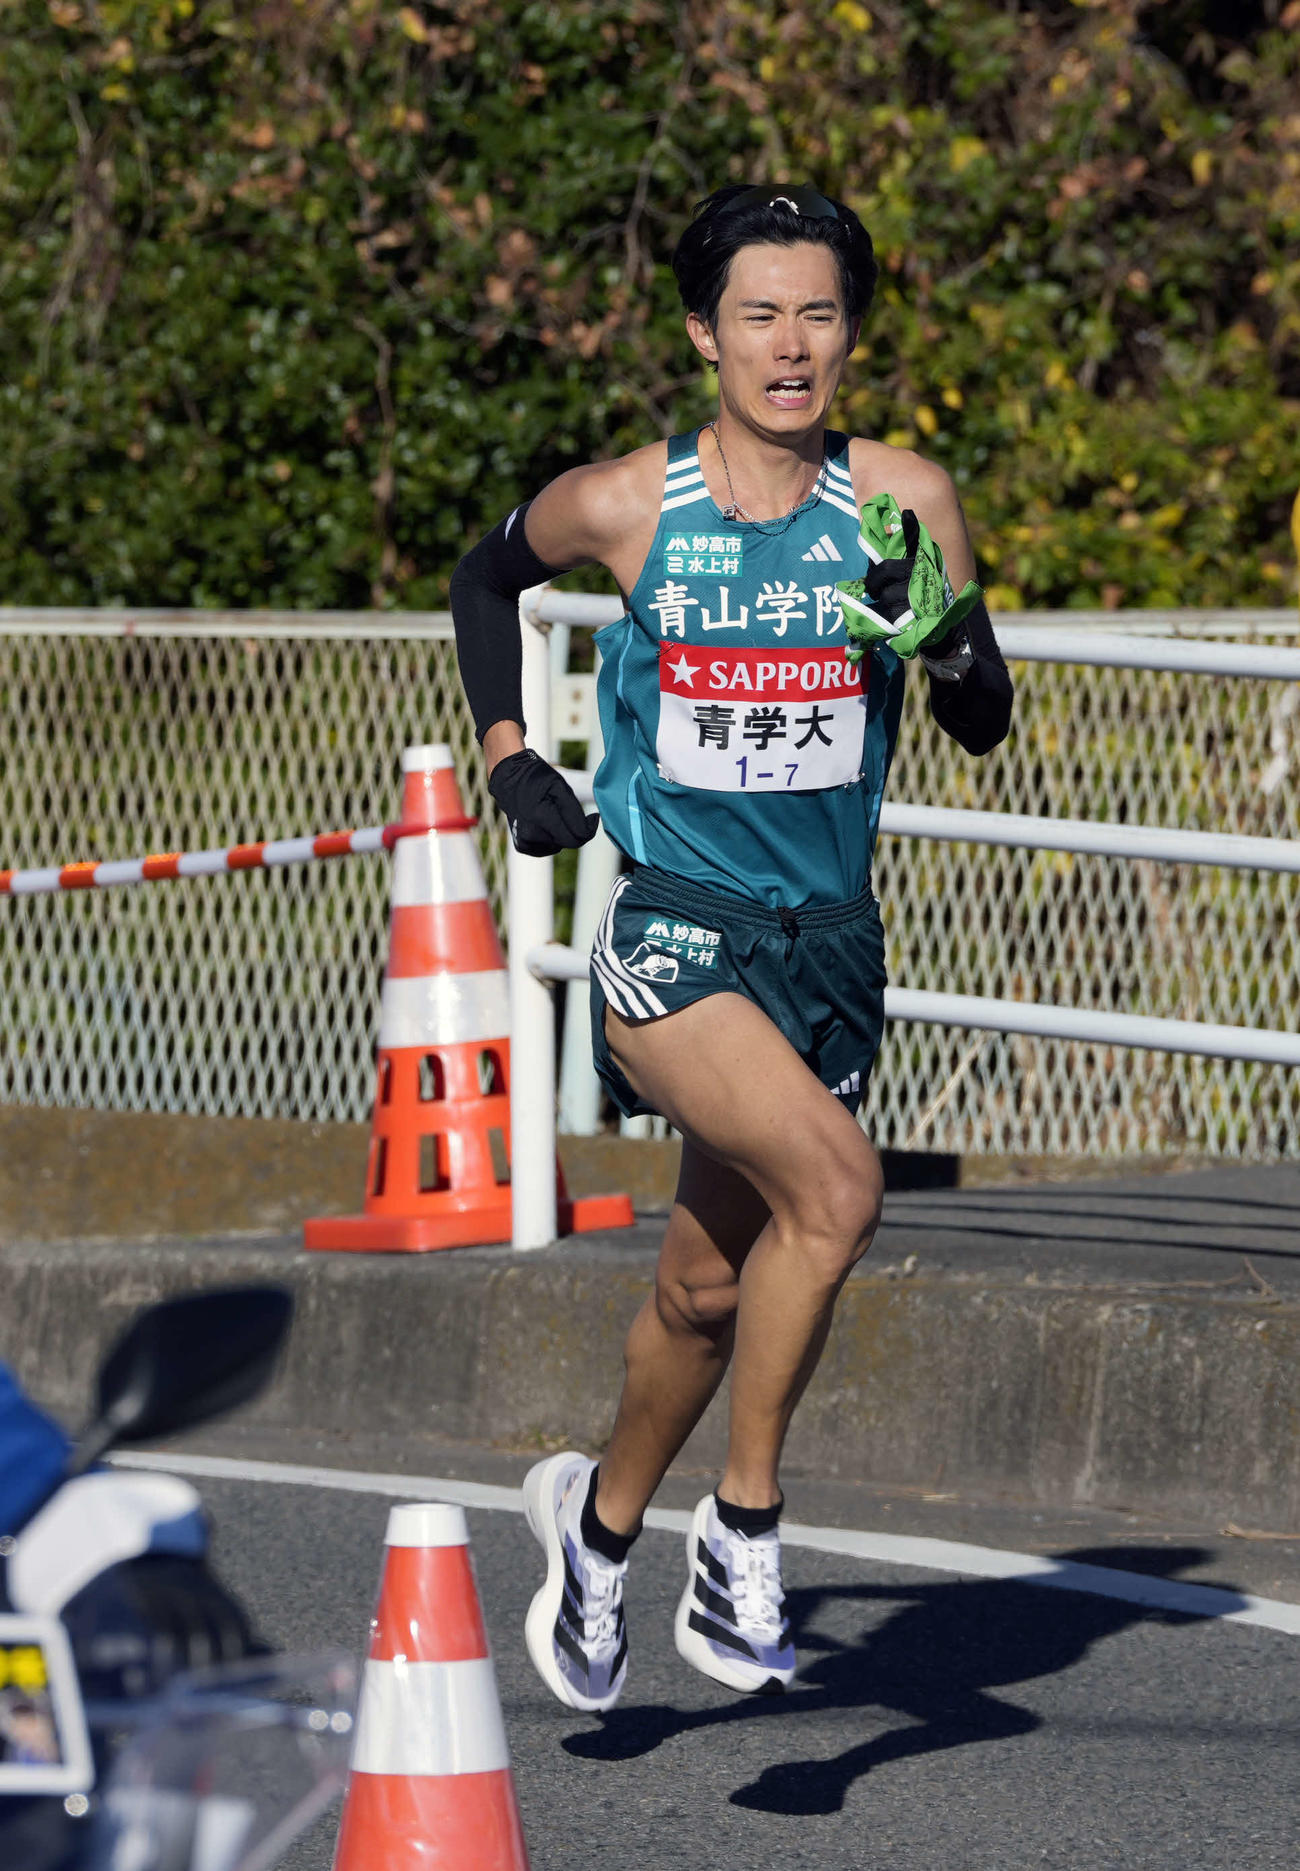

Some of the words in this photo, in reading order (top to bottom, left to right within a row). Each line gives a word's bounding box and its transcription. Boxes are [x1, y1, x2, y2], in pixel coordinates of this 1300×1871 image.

[692, 536, 742, 553] 妙高市
[688, 556, 739, 575] 水上村
[709, 660, 863, 691] SAPPORO
[693, 704, 834, 750] 青学大
[672, 923, 722, 946] 妙高市
